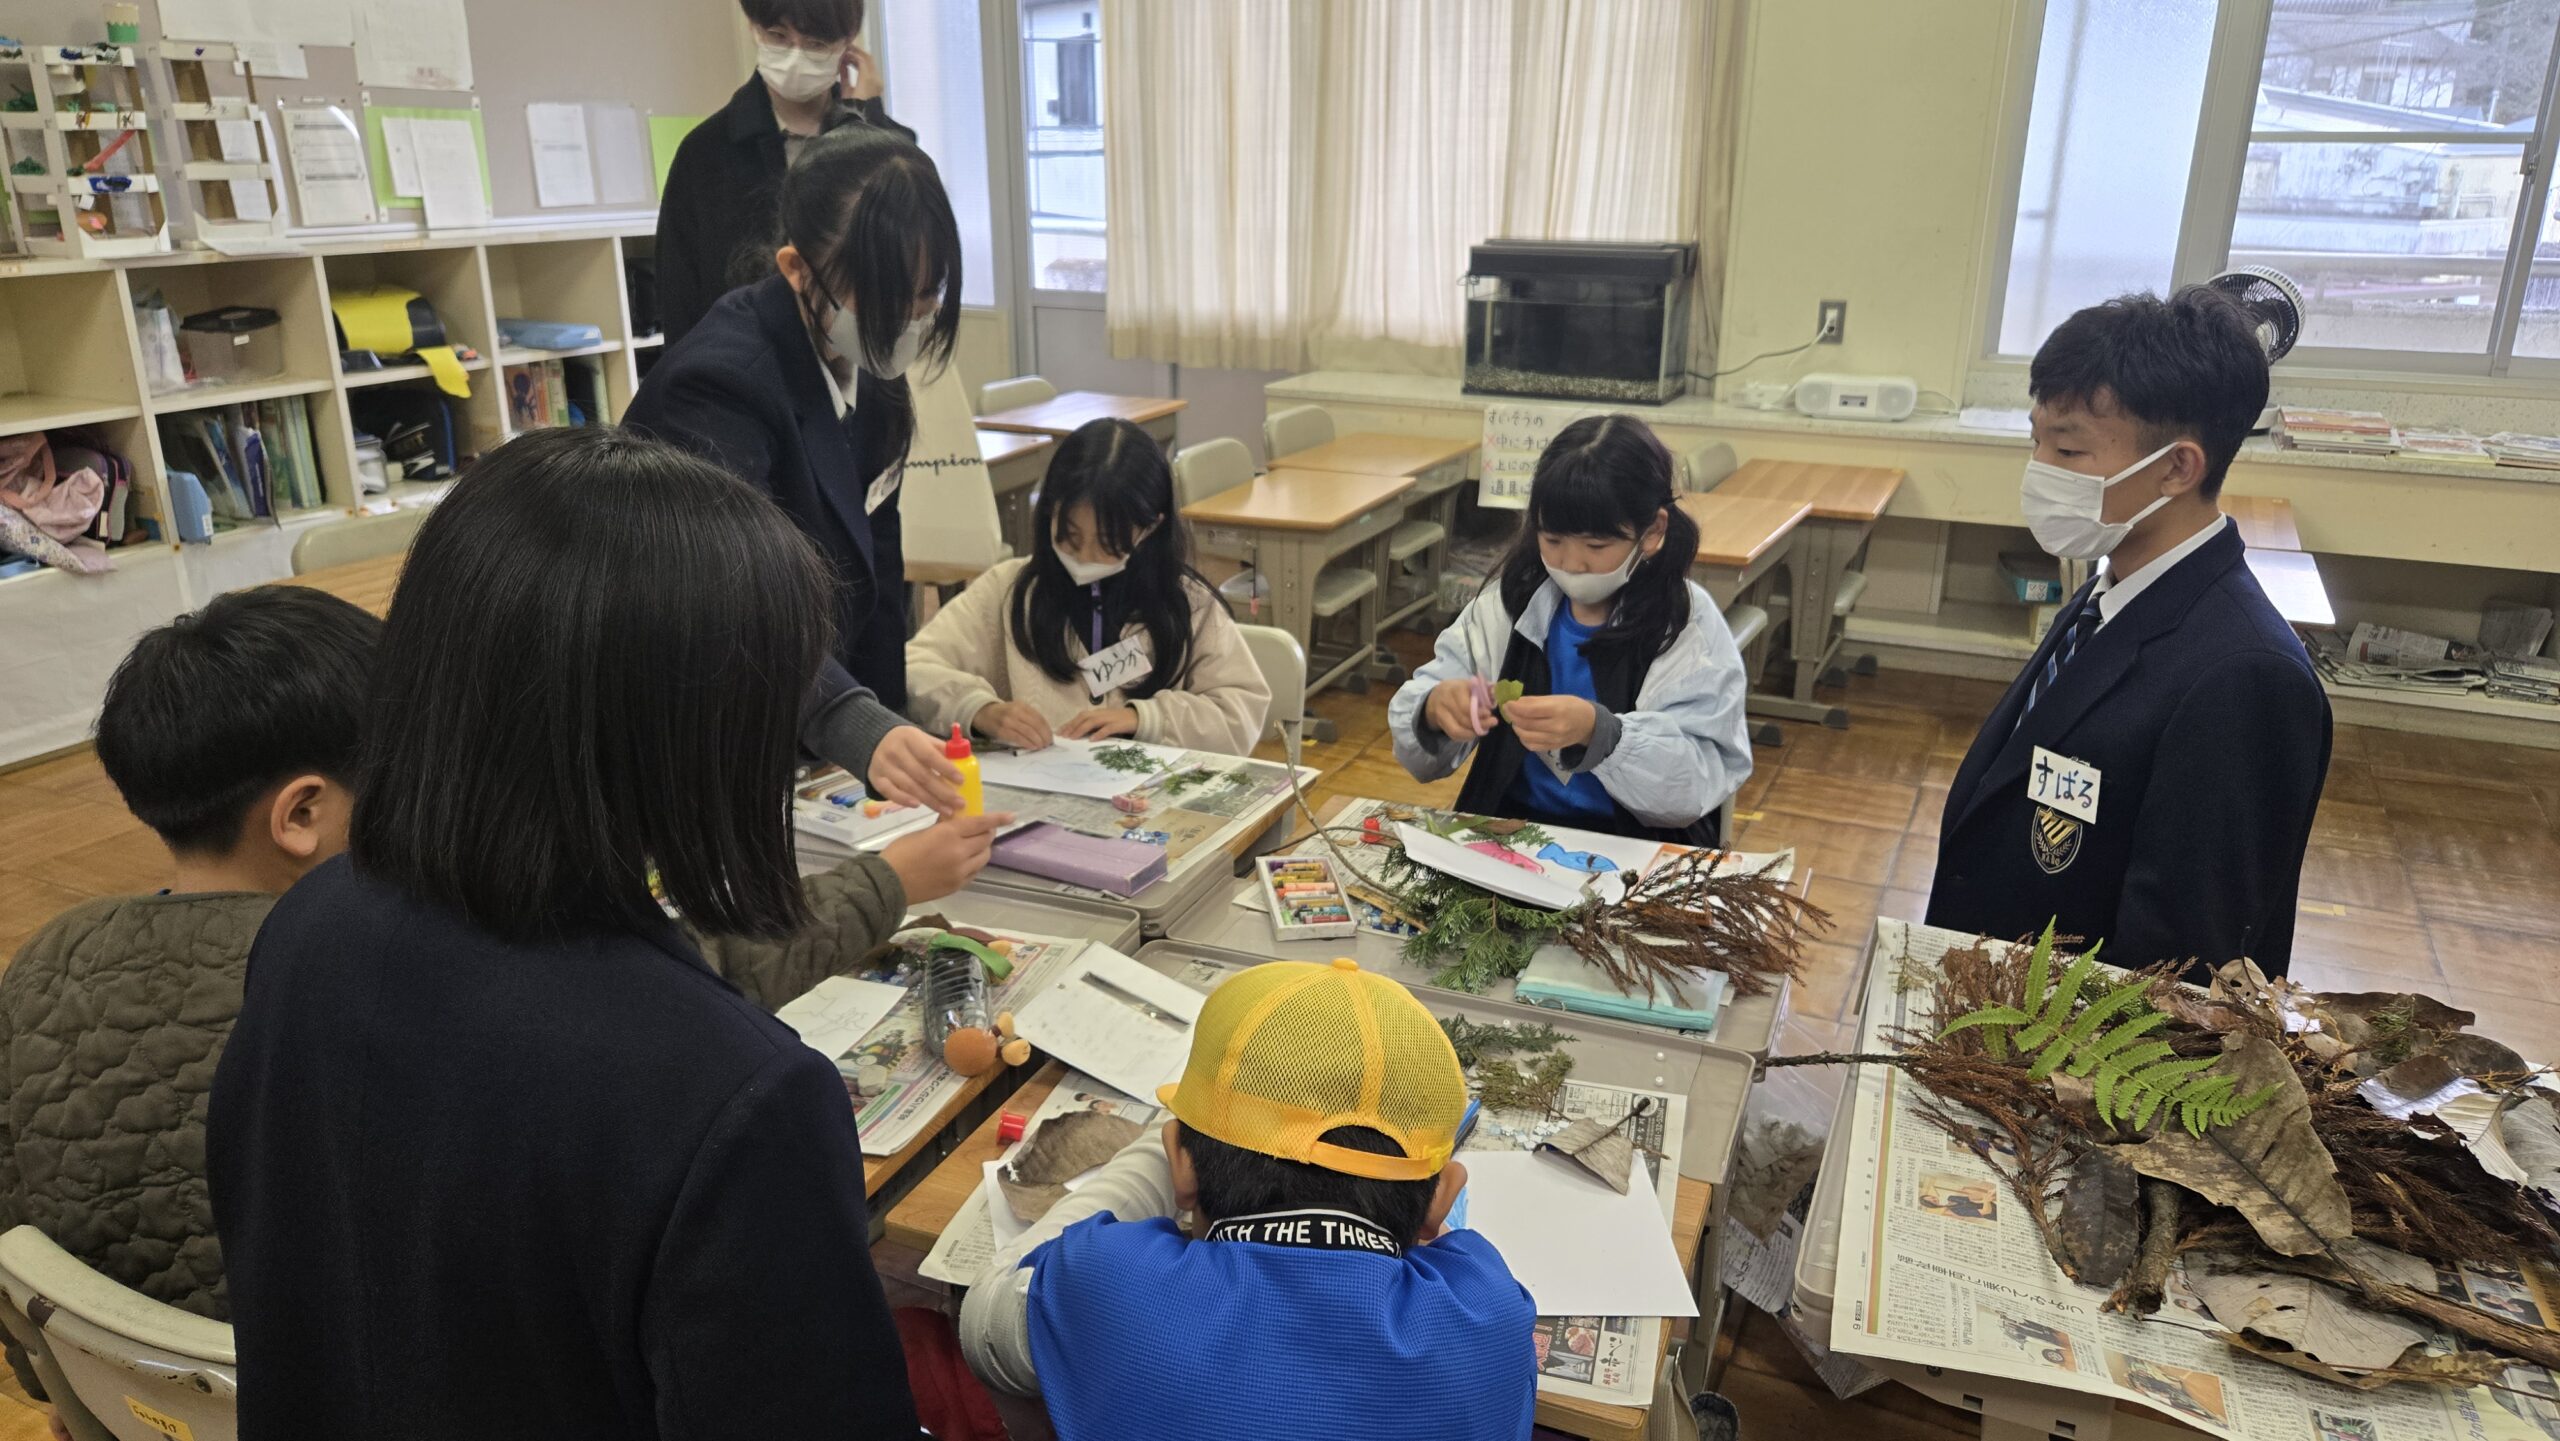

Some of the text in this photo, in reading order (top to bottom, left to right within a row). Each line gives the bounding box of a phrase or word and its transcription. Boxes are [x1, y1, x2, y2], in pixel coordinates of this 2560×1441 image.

[1488, 409, 1543, 427] すいそうの
[1092, 647, 1144, 683] ゆうか
[2035, 756, 2094, 809] すばる
[1213, 1221, 1395, 1254] ITH THE THREE
